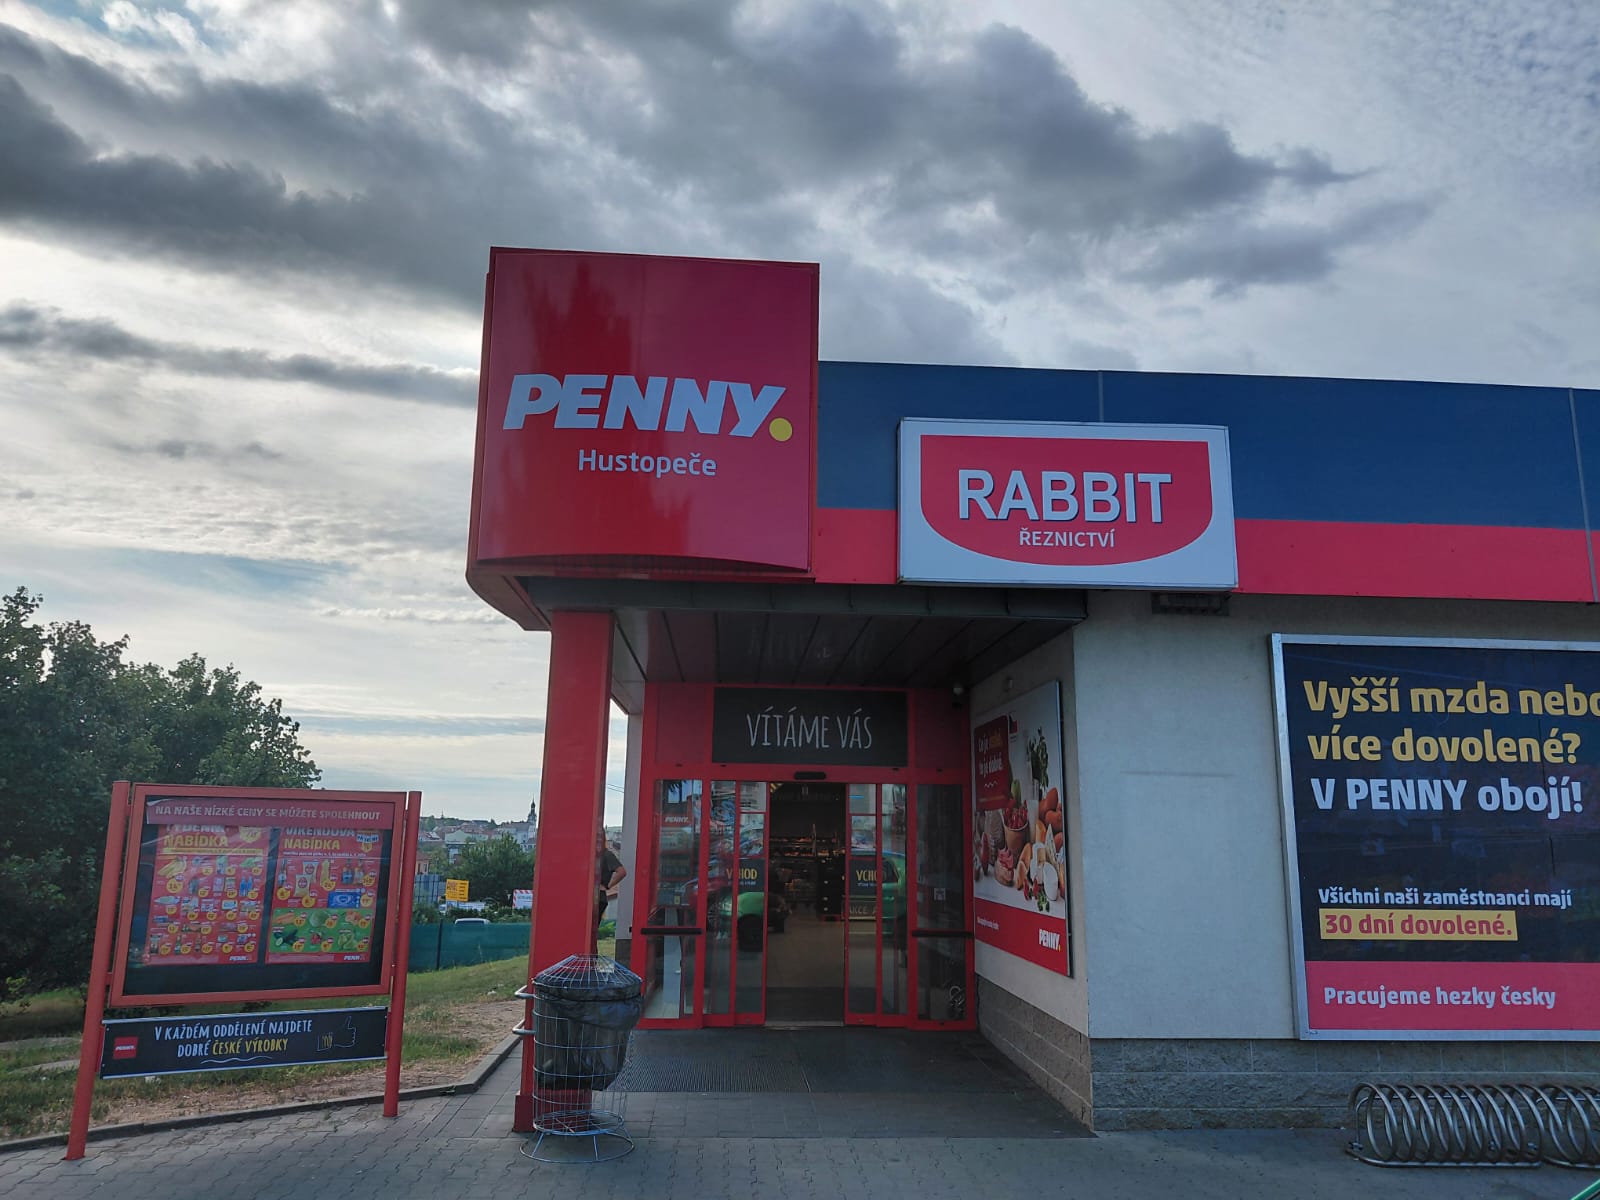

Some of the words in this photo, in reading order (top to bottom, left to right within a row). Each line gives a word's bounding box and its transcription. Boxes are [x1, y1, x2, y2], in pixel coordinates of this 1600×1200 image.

[503, 373, 793, 442] PENNY.
[578, 449, 717, 478] Hustopeče
[958, 468, 1173, 524] RABBIT
[1019, 527, 1115, 548] ŘEZNICTVÍ
[1303, 676, 1400, 719] Vyšší
[1410, 681, 1510, 714] mzda
[746, 705, 830, 749] VÍTÁME
[836, 707, 873, 750] VÁS
[1307, 724, 1381, 761] více
[1391, 727, 1581, 764] dovolené?
[1310, 778, 1336, 810] V
[1346, 778, 1467, 811] PENNY
[1478, 776, 1583, 820] obojí!
[155, 805, 171, 815] NA
[174, 804, 202, 816] NAŠE
[204, 804, 235, 817] NÍZKÉ
[237, 807, 264, 817] CENY
[265, 808, 277, 818] SE
[279, 806, 317, 819] MŮŽETE
[319, 810, 381, 821] SPOLEHNOUT
[164, 832, 229, 847] NABÍDKA
[284, 836, 341, 850] NABÍDKA
[725, 867, 758, 880] VHOD
[1318, 887, 1380, 904] Všichni
[1383, 888, 1418, 905] naši
[1423, 888, 1530, 907] zaměstnanci
[1534, 891, 1572, 909] mají
[1325, 914, 1352, 934] 30
[1358, 913, 1394, 935] dní
[1400, 914, 1513, 936] dovolené.
[1324, 985, 1431, 1009] Pracujeme
[1435, 986, 1497, 1010] hezky
[1501, 985, 1556, 1010] česky
[154, 1026, 163, 1041] V
[164, 1022, 211, 1039] KAŽDÉM
[213, 1019, 266, 1037] ODDĚLENÍ
[268, 1019, 313, 1034] NAJDETE
[177, 1040, 210, 1058] DOBRÉ
[212, 1038, 241, 1055] ČESKÉ
[245, 1037, 288, 1053] VÝROBKY
